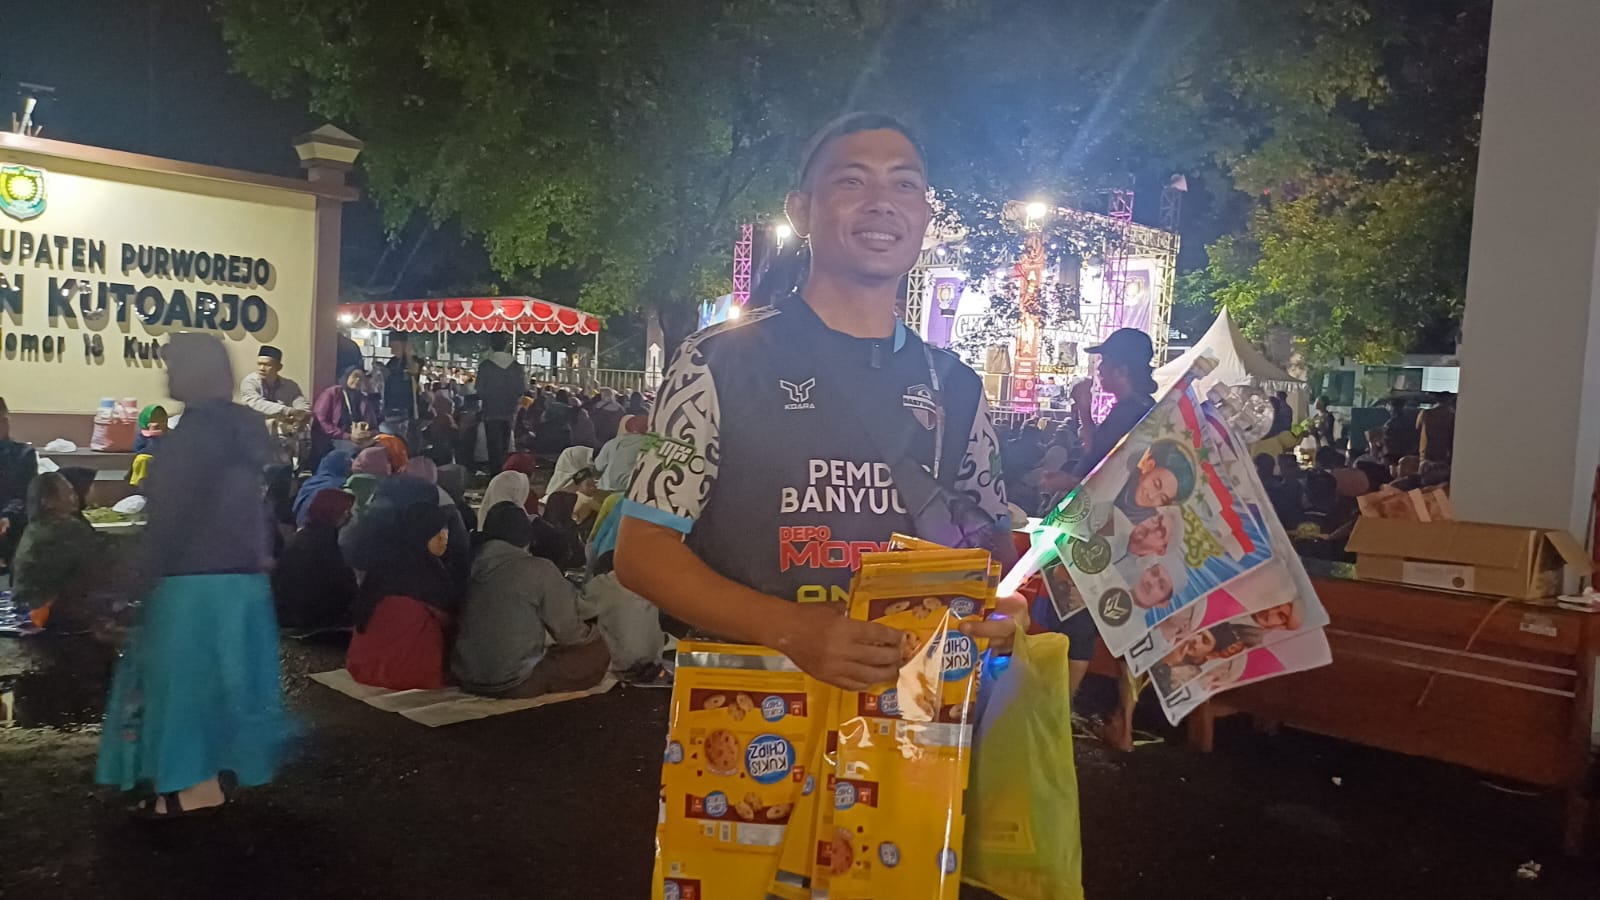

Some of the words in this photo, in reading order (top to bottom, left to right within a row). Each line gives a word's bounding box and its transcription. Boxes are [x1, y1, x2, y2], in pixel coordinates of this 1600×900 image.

[121, 242, 270, 286] PURWOREJO
[48, 276, 268, 333] KUTOARJO
[0, 329, 65, 355] omor
[808, 459, 894, 488] PEMD
[779, 525, 831, 542] DEPO
